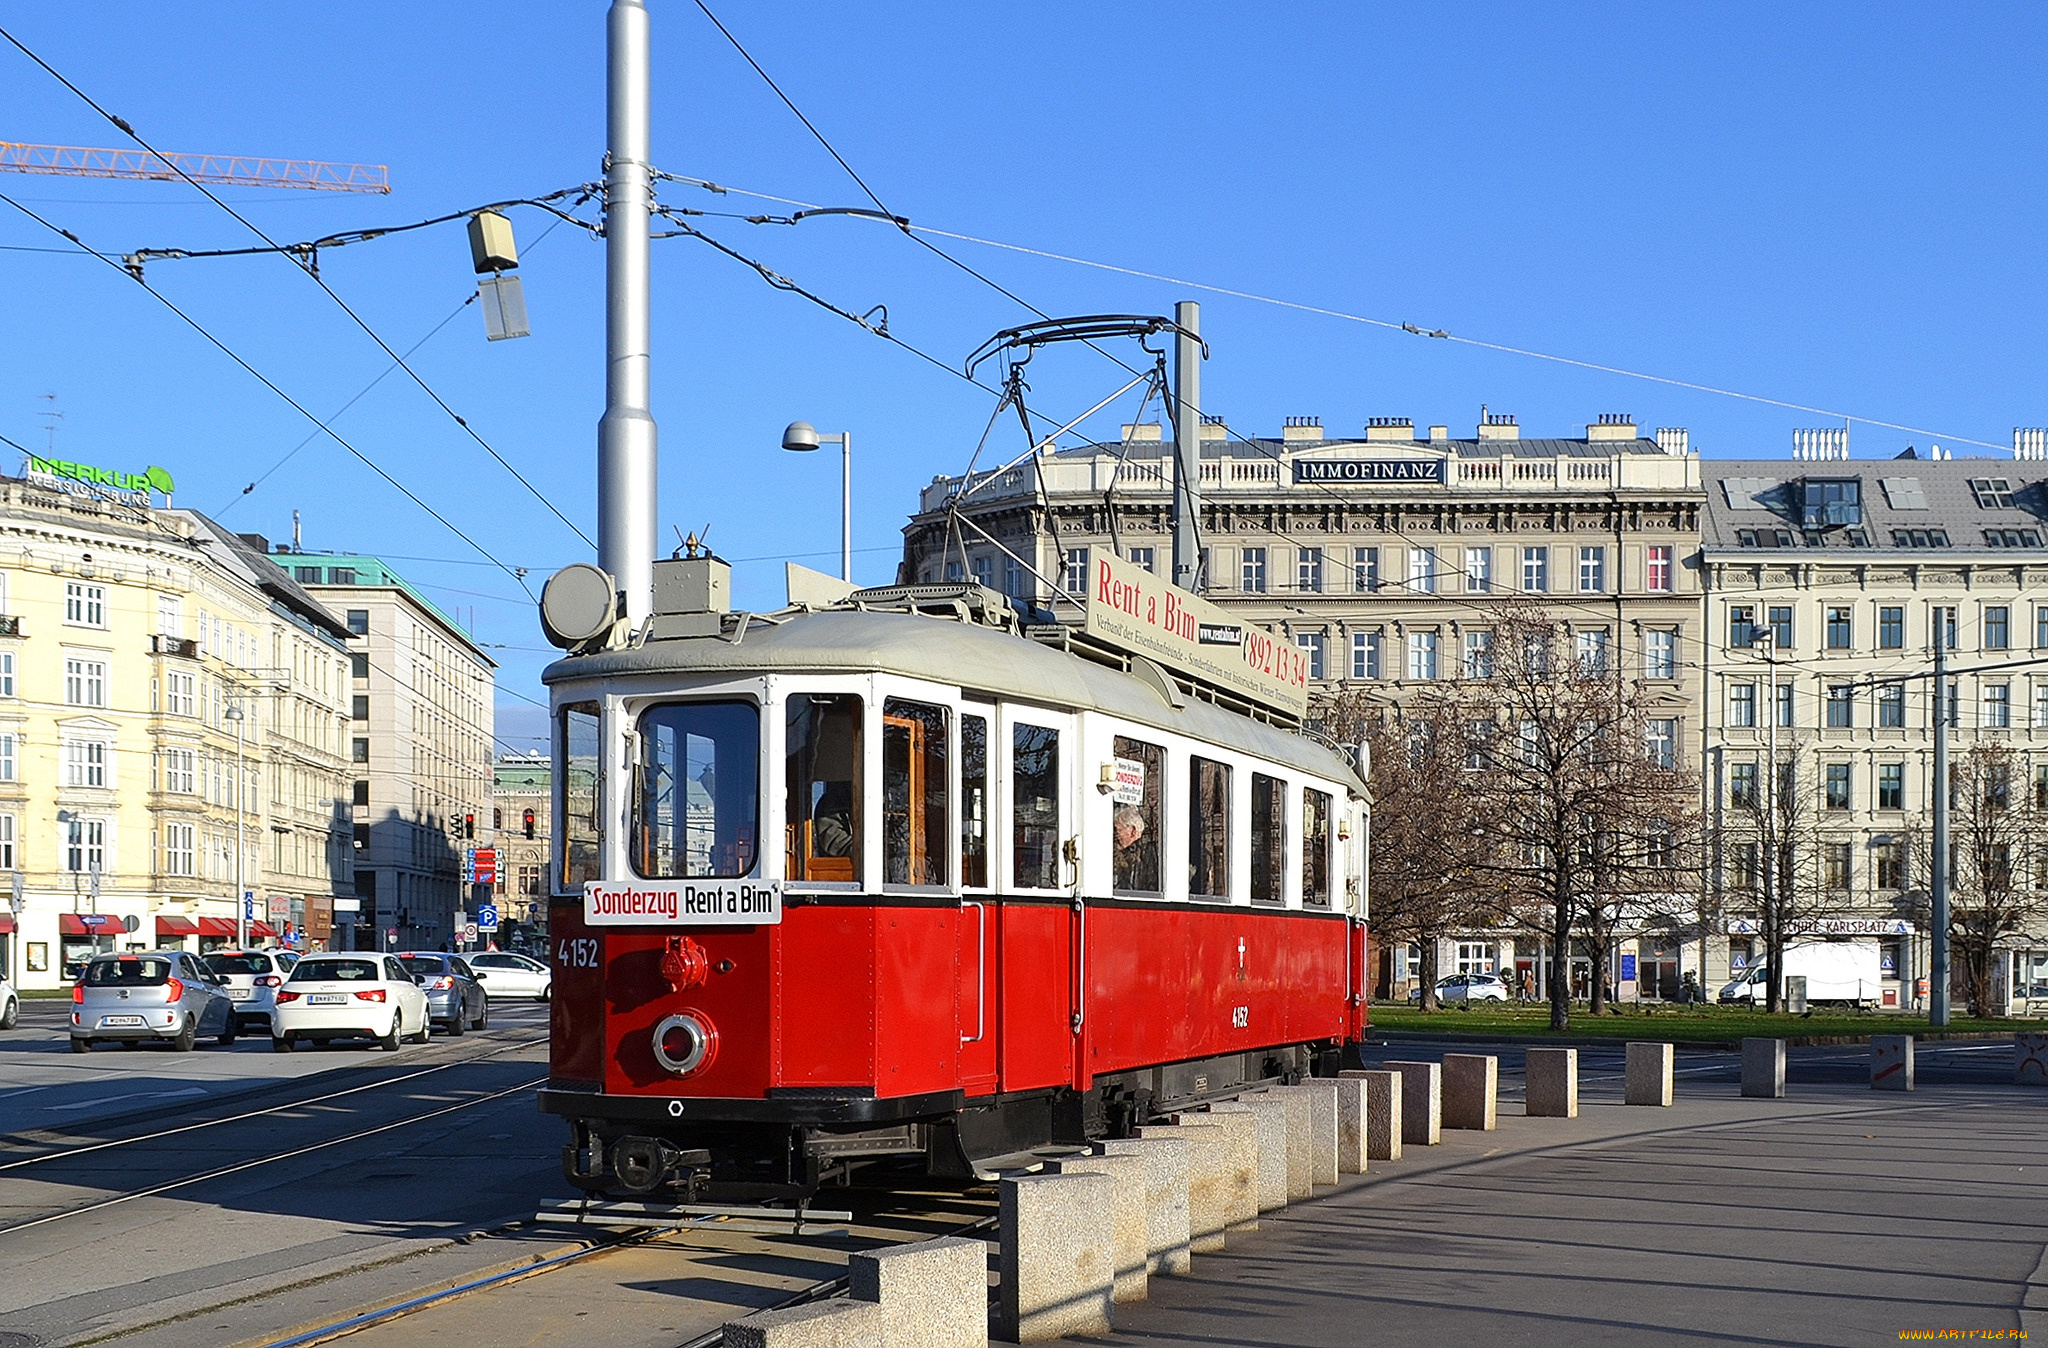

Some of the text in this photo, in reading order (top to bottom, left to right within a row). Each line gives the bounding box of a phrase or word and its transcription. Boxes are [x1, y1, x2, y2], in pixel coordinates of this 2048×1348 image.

[31, 456, 151, 494] MERKUR
[1301, 463, 1437, 478] IMMOFINANZ
[1097, 558, 1196, 643] Rent a Bim
[1123, 626, 1134, 642] der
[1135, 630, 1184, 662] Eisenbahnfreunde
[1249, 632, 1306, 689] 892 13 34
[593, 885, 773, 919] Sonderzug Rent a Bim
[1825, 920, 1888, 933] KARLSPLATZ
[558, 938, 598, 968] 4152
[1232, 1005, 1249, 1029] 4152
